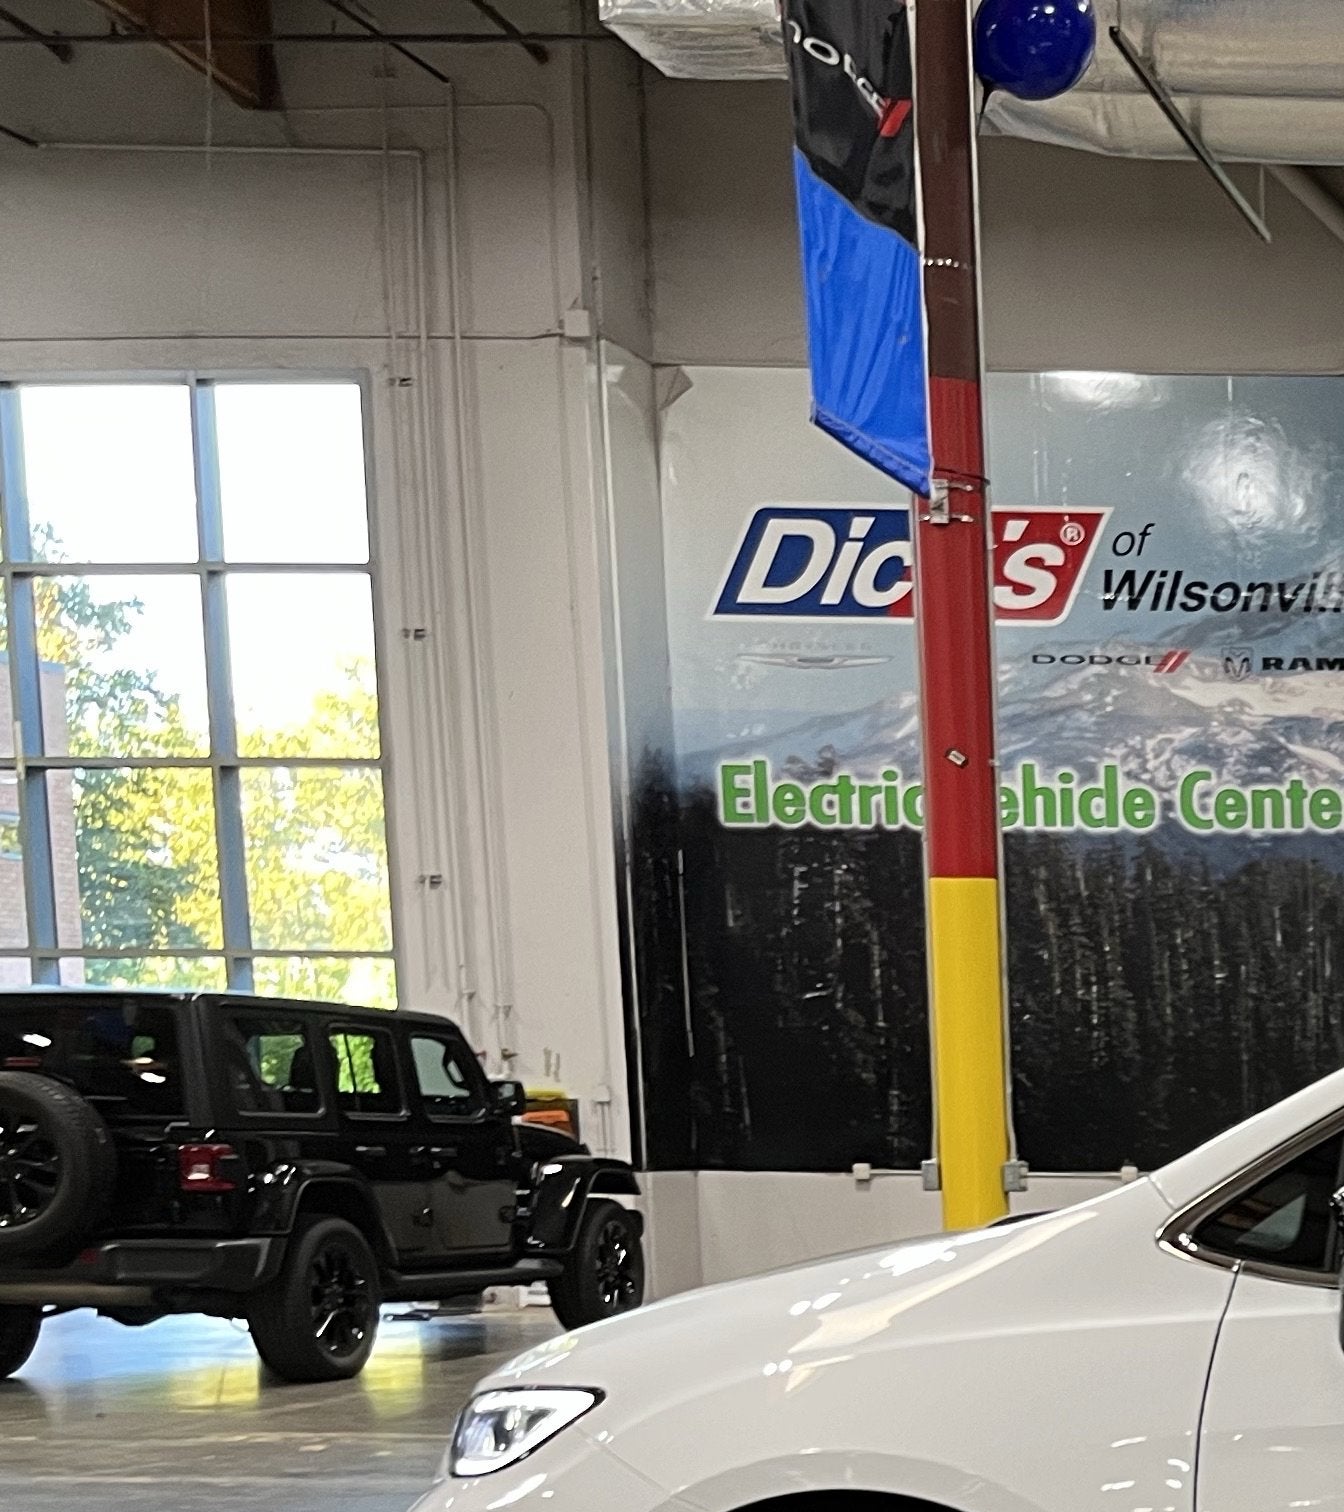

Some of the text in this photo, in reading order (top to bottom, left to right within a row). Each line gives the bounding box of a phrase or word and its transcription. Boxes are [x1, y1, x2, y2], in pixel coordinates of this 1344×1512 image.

[736, 516, 1155, 610] Dic's of
[722, 761, 924, 827] Electric
[1000, 764, 1155, 829] ehicle
